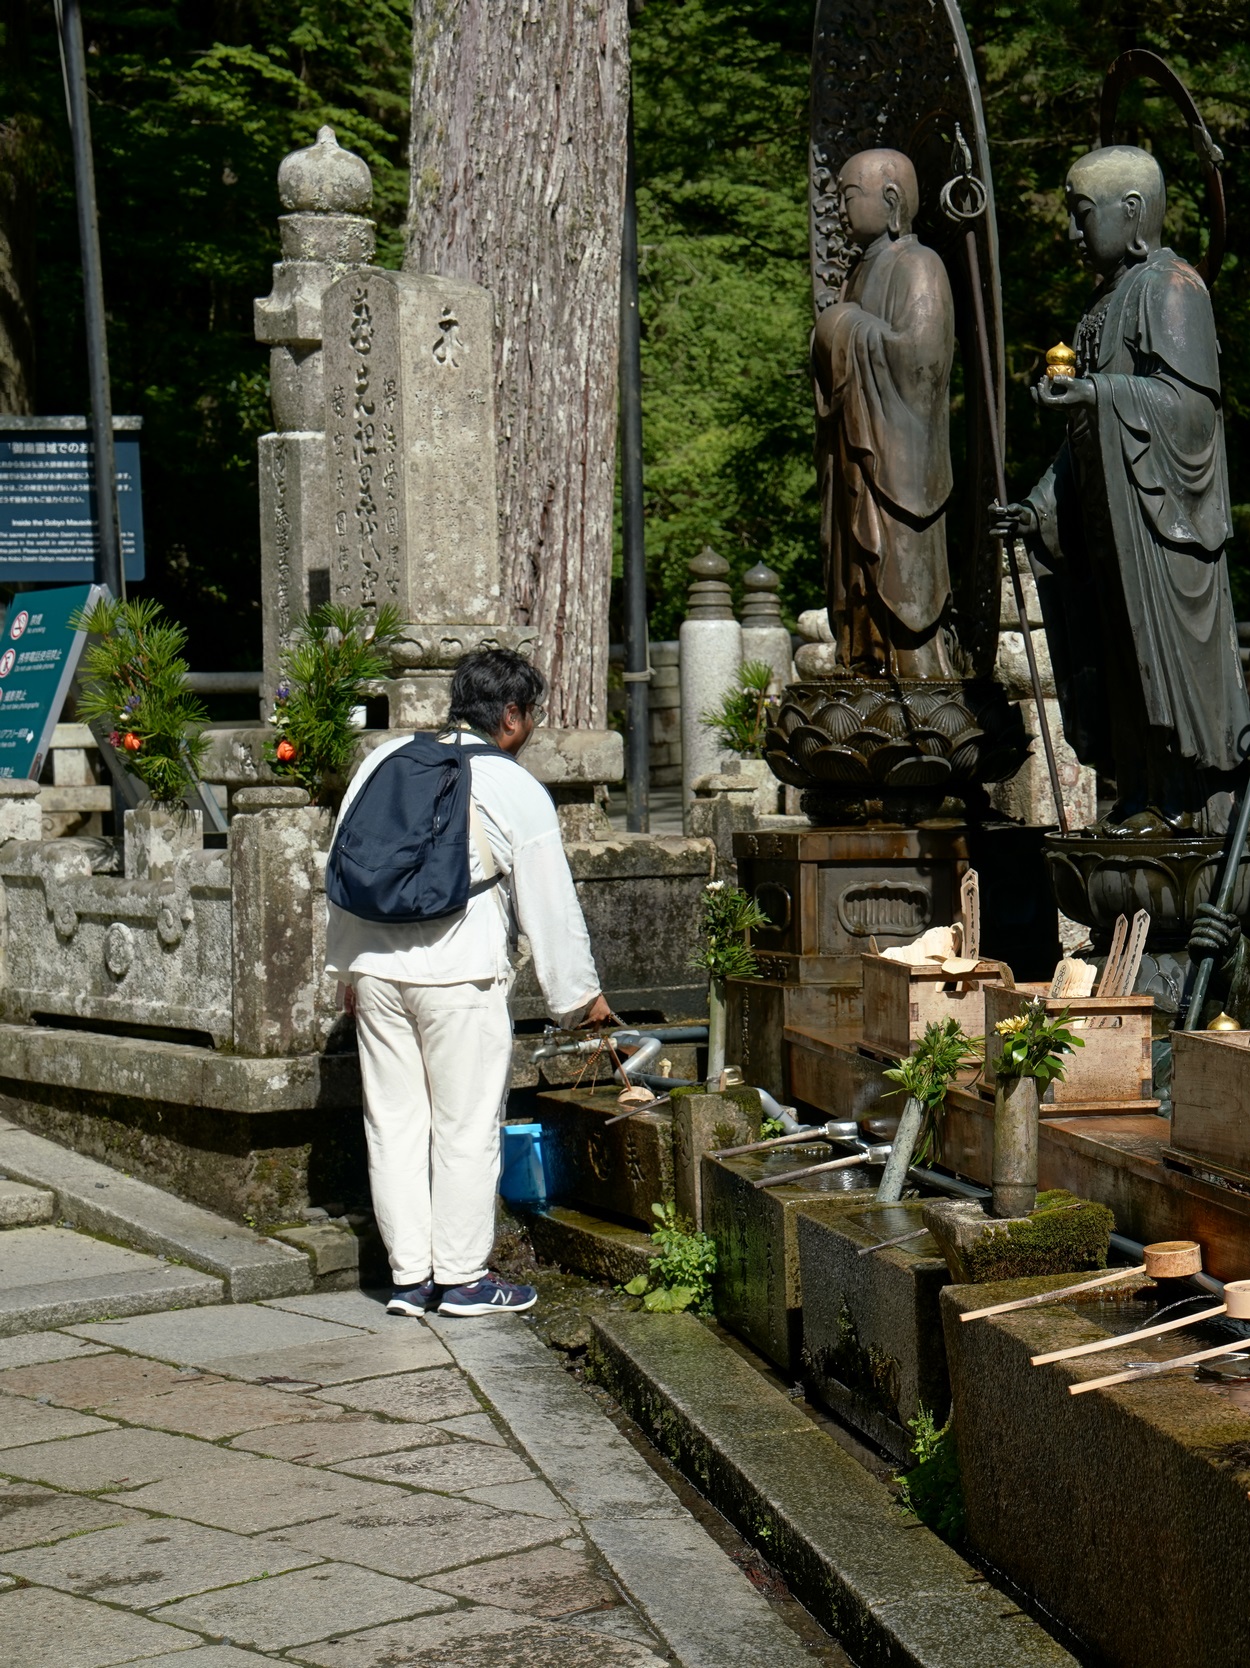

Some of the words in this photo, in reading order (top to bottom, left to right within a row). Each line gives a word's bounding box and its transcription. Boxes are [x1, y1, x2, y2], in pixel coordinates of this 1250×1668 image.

[12, 519, 32, 527] Inside
[32, 519, 43, 527] the
[44, 519, 65, 527] Gobyo
